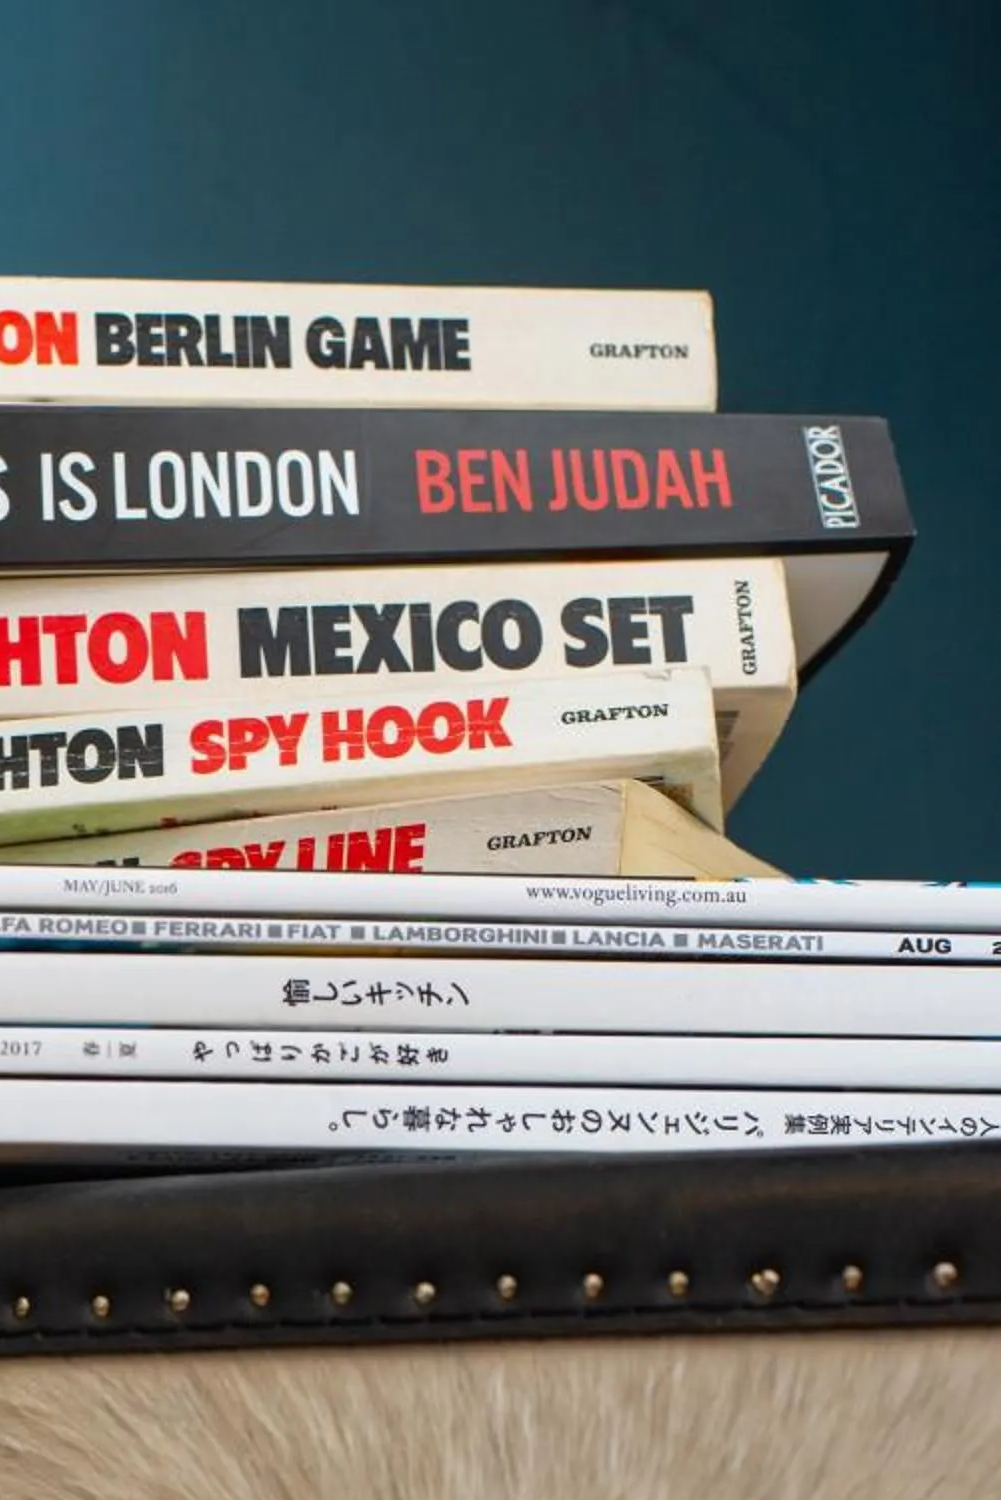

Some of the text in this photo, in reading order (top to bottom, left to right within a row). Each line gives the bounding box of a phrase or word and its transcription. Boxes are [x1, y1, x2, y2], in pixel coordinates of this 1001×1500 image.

[95, 313, 291, 368] BERLIN
[306, 316, 471, 371] GAME
[590, 344, 688, 358] GRAFTON
[41, 452, 97, 520] IS
[114, 450, 359, 519] LONDON
[415, 448, 732, 513] BEN JUDAH
[804, 425, 860, 529] PICADOR
[238, 599, 542, 678] MEXICO
[561, 596, 693, 668] SET
[735, 581, 757, 675] GRAFTON
[561, 704, 668, 724] GRAFTON
[190, 697, 512, 774] SPY HOOK
[487, 827, 591, 850] GRAFTON
[64, 880, 144, 896] MAY/JUNE
[527, 884, 746, 907] www.vogueliving.com.au
[39, 918, 128, 936] ROMEO
[154, 921, 262, 939] FERRARI
[288, 924, 339, 939] FIAT
[373, 925, 547, 945] LAMBORGHINI
[573, 928, 665, 948] LANCIA
[698, 932, 824, 952] MASERATI
[898, 938, 951, 954] AUG
[283, 980, 469, 1006] 愉しいキッチン
[1, 1041, 41, 1056] 2017
[785, 1115, 1001, 1137] 人のインテリア実例集
